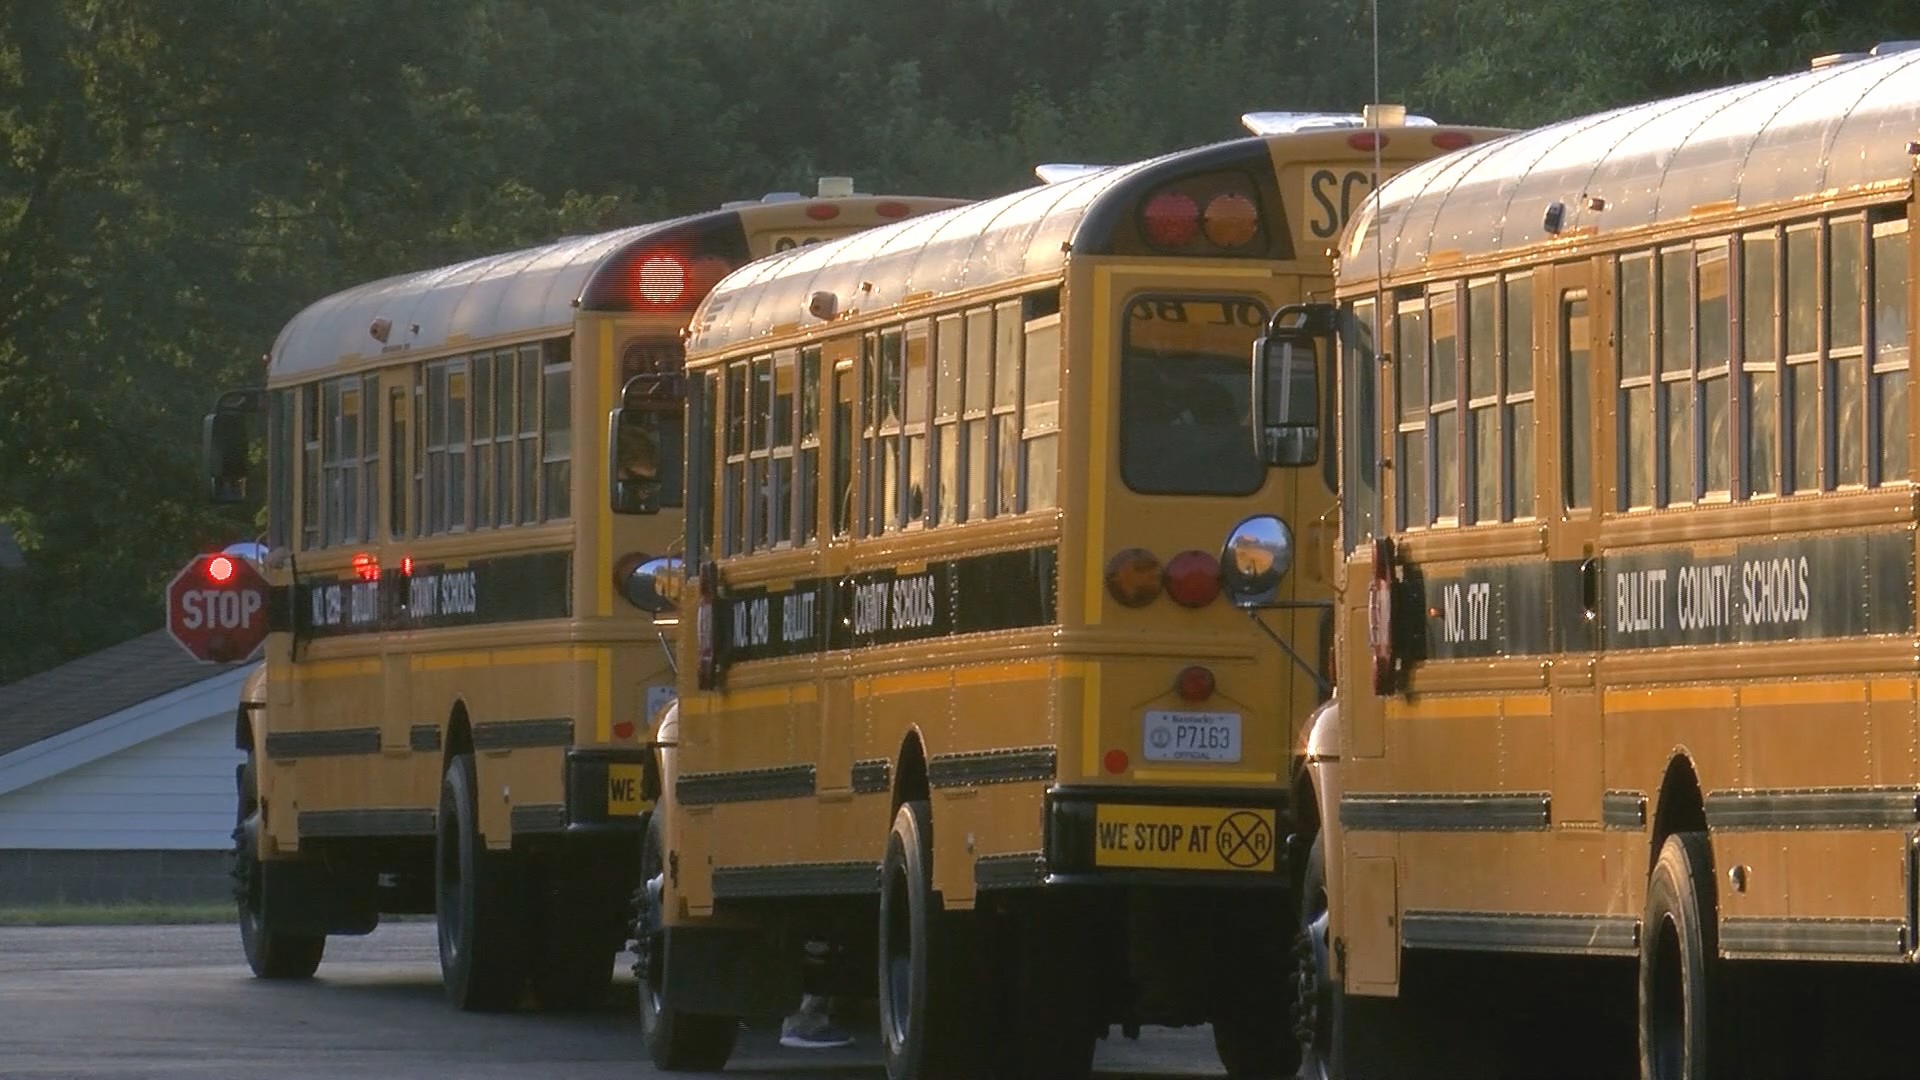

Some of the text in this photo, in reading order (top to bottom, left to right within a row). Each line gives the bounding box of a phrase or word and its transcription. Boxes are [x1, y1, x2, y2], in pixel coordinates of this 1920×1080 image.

[183, 590, 261, 629] STOP
[442, 571, 476, 615] SCHOOLS
[854, 582, 889, 635] COUNTY
[892, 574, 935, 630] SCHOOLS
[1444, 556, 1809, 643] NO. 177 BULLITT COUNTY SCHOOLS
[1176, 726, 1230, 749] P7163
[611, 778, 635, 801] WE
[1100, 822, 1128, 850] WE
[1134, 822, 1184, 852] STOP
[1188, 825, 1212, 853] AT
